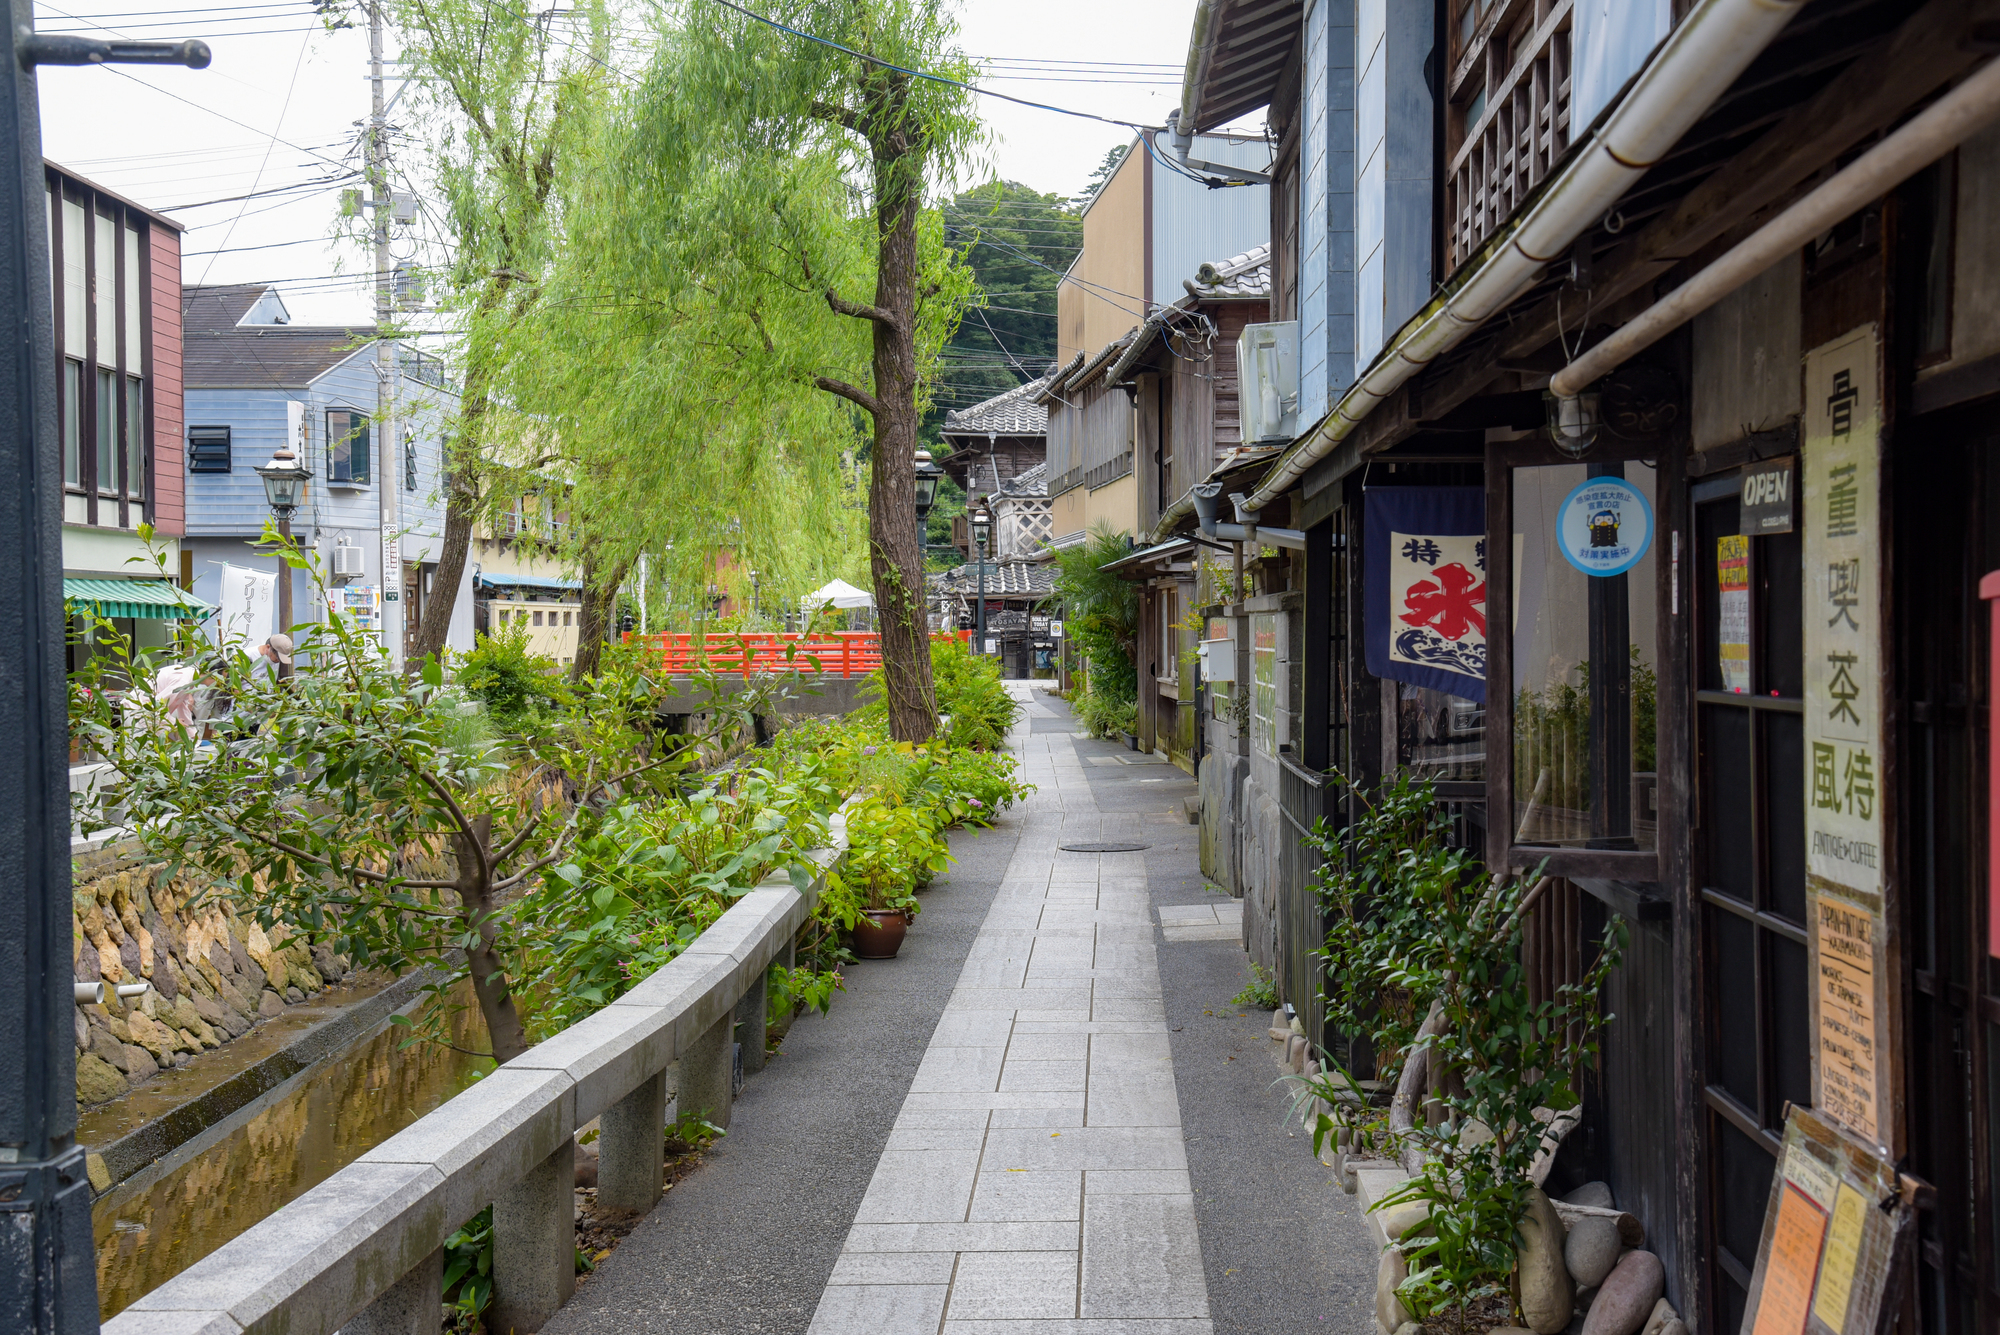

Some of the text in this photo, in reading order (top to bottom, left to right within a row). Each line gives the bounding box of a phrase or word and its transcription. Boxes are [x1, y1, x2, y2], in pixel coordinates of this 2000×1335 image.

[1576, 491, 1632, 504] 感染症拡大防止
[1743, 470, 1790, 507] OPEN
[1588, 500, 1620, 510] 宣言の店
[1580, 546, 1630, 559] 対策実施中
[1826, 367, 1860, 727] 骨董喫茶
[261, 578, 270, 603] ひとり
[1398, 562, 1486, 642] 氷
[1811, 740, 1875, 822] 風待
[1849, 841, 1878, 869] COFFEE
